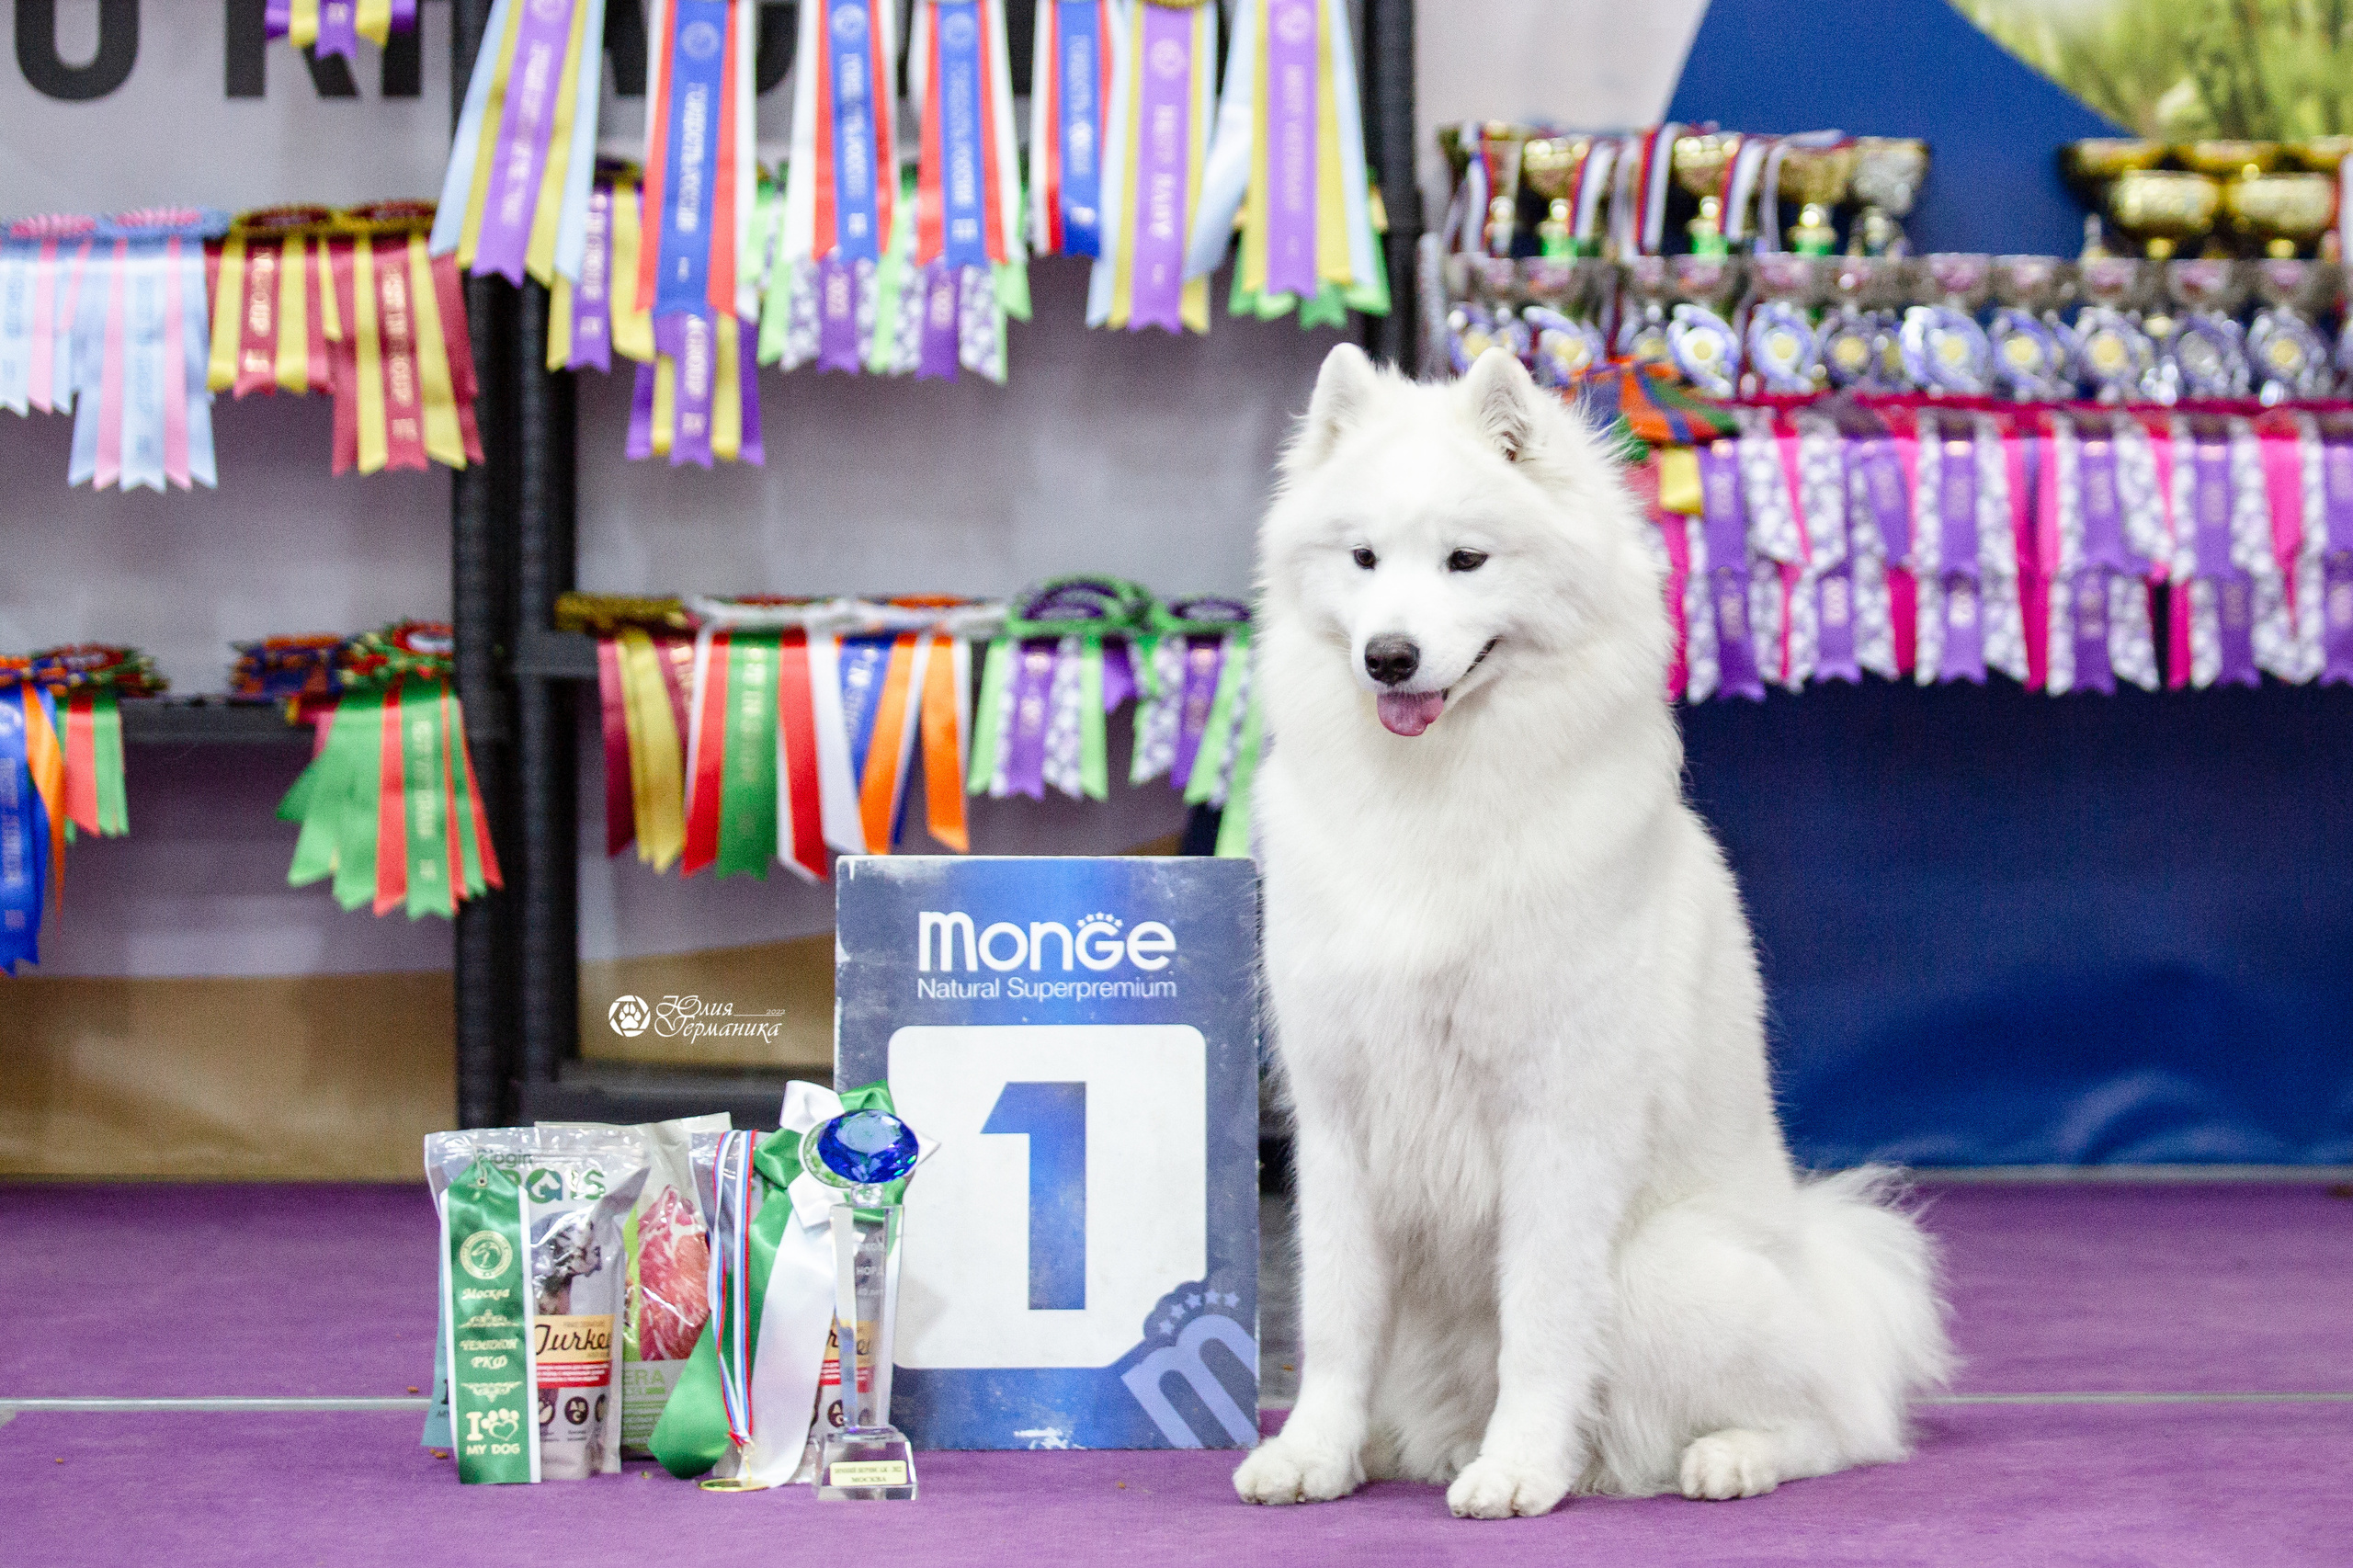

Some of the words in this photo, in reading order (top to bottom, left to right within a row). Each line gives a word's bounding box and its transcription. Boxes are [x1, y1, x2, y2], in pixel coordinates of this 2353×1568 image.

[917, 977, 1000, 999] Natural
[1006, 976, 1176, 1002] Superpremium
[980, 1081, 1087, 1310] 1
[466, 1445, 487, 1455] MY
[491, 1444, 520, 1455] DOG
